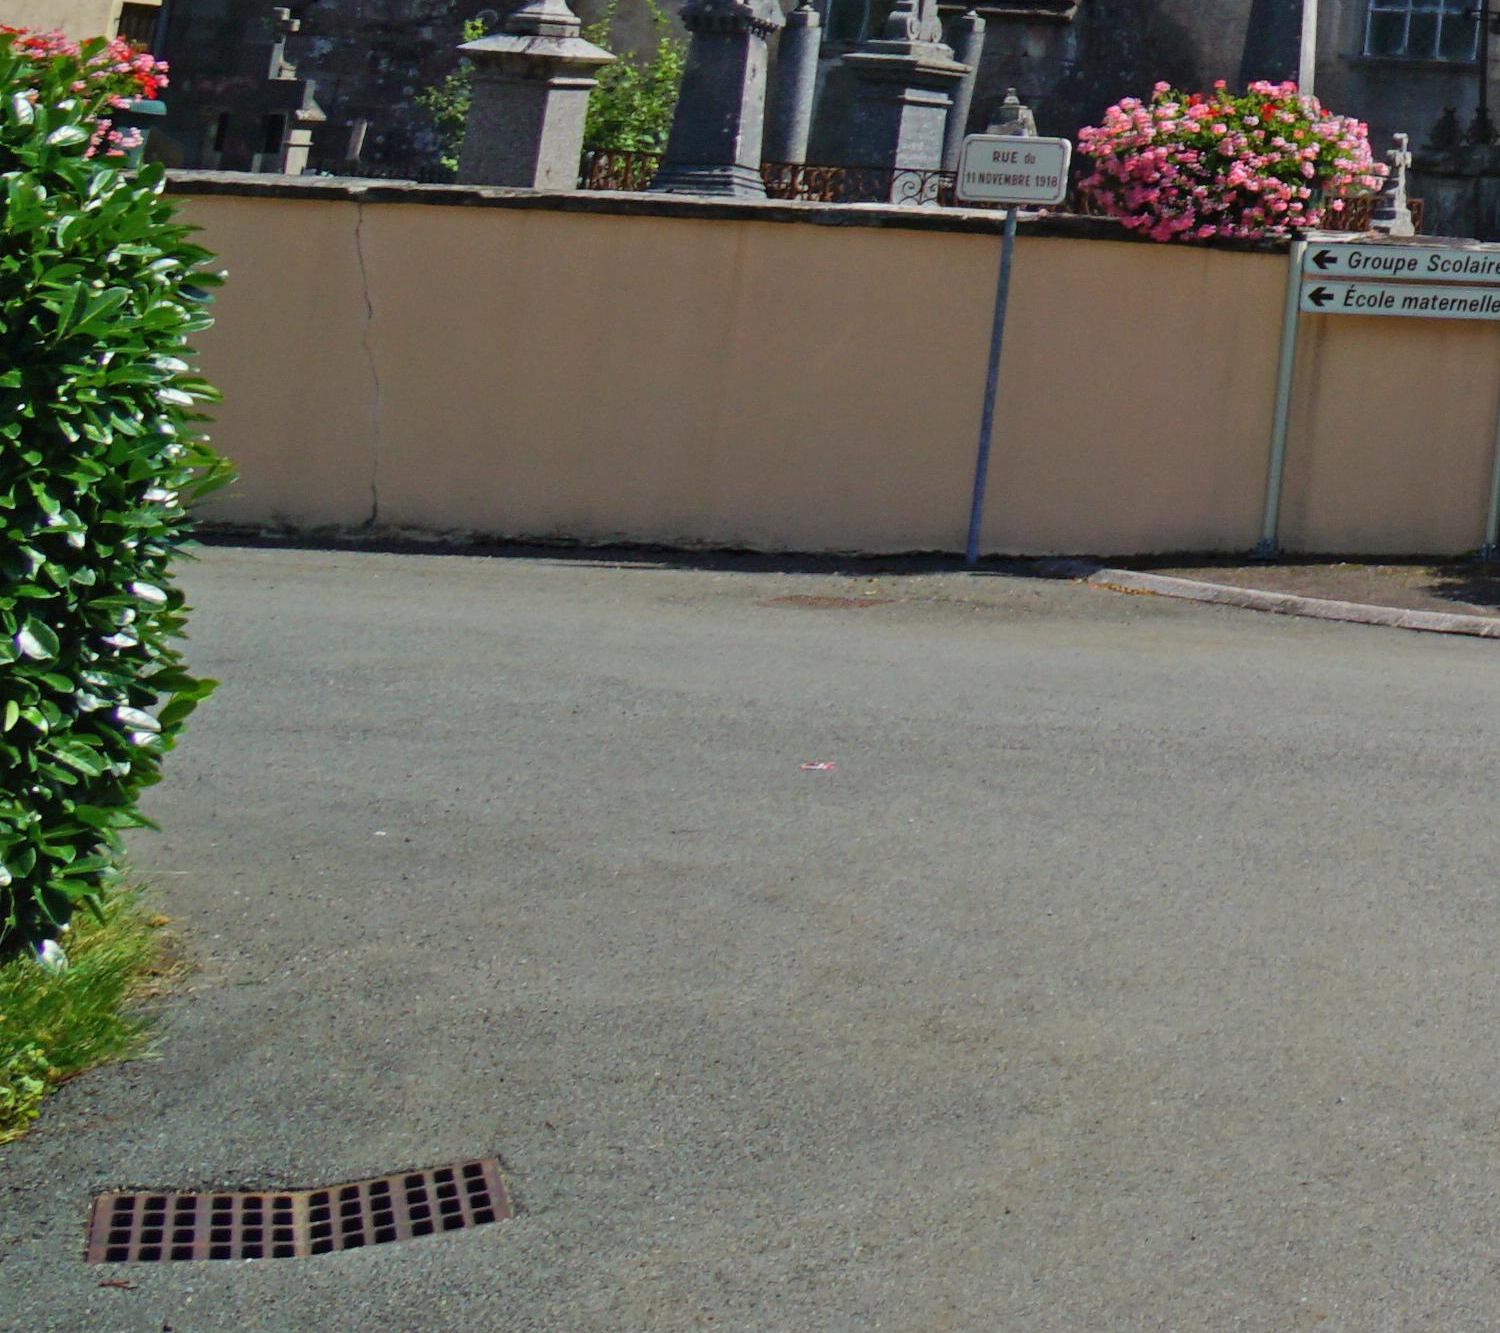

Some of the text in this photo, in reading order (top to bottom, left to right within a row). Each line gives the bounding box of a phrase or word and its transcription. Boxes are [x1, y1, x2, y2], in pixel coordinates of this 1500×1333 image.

[992, 150, 1036, 164] RUE du
[966, 171, 1058, 188] 11 NOVEMBRE 1918
[1348, 251, 1418, 275] Groupe
[1343, 284, 1395, 309] École
